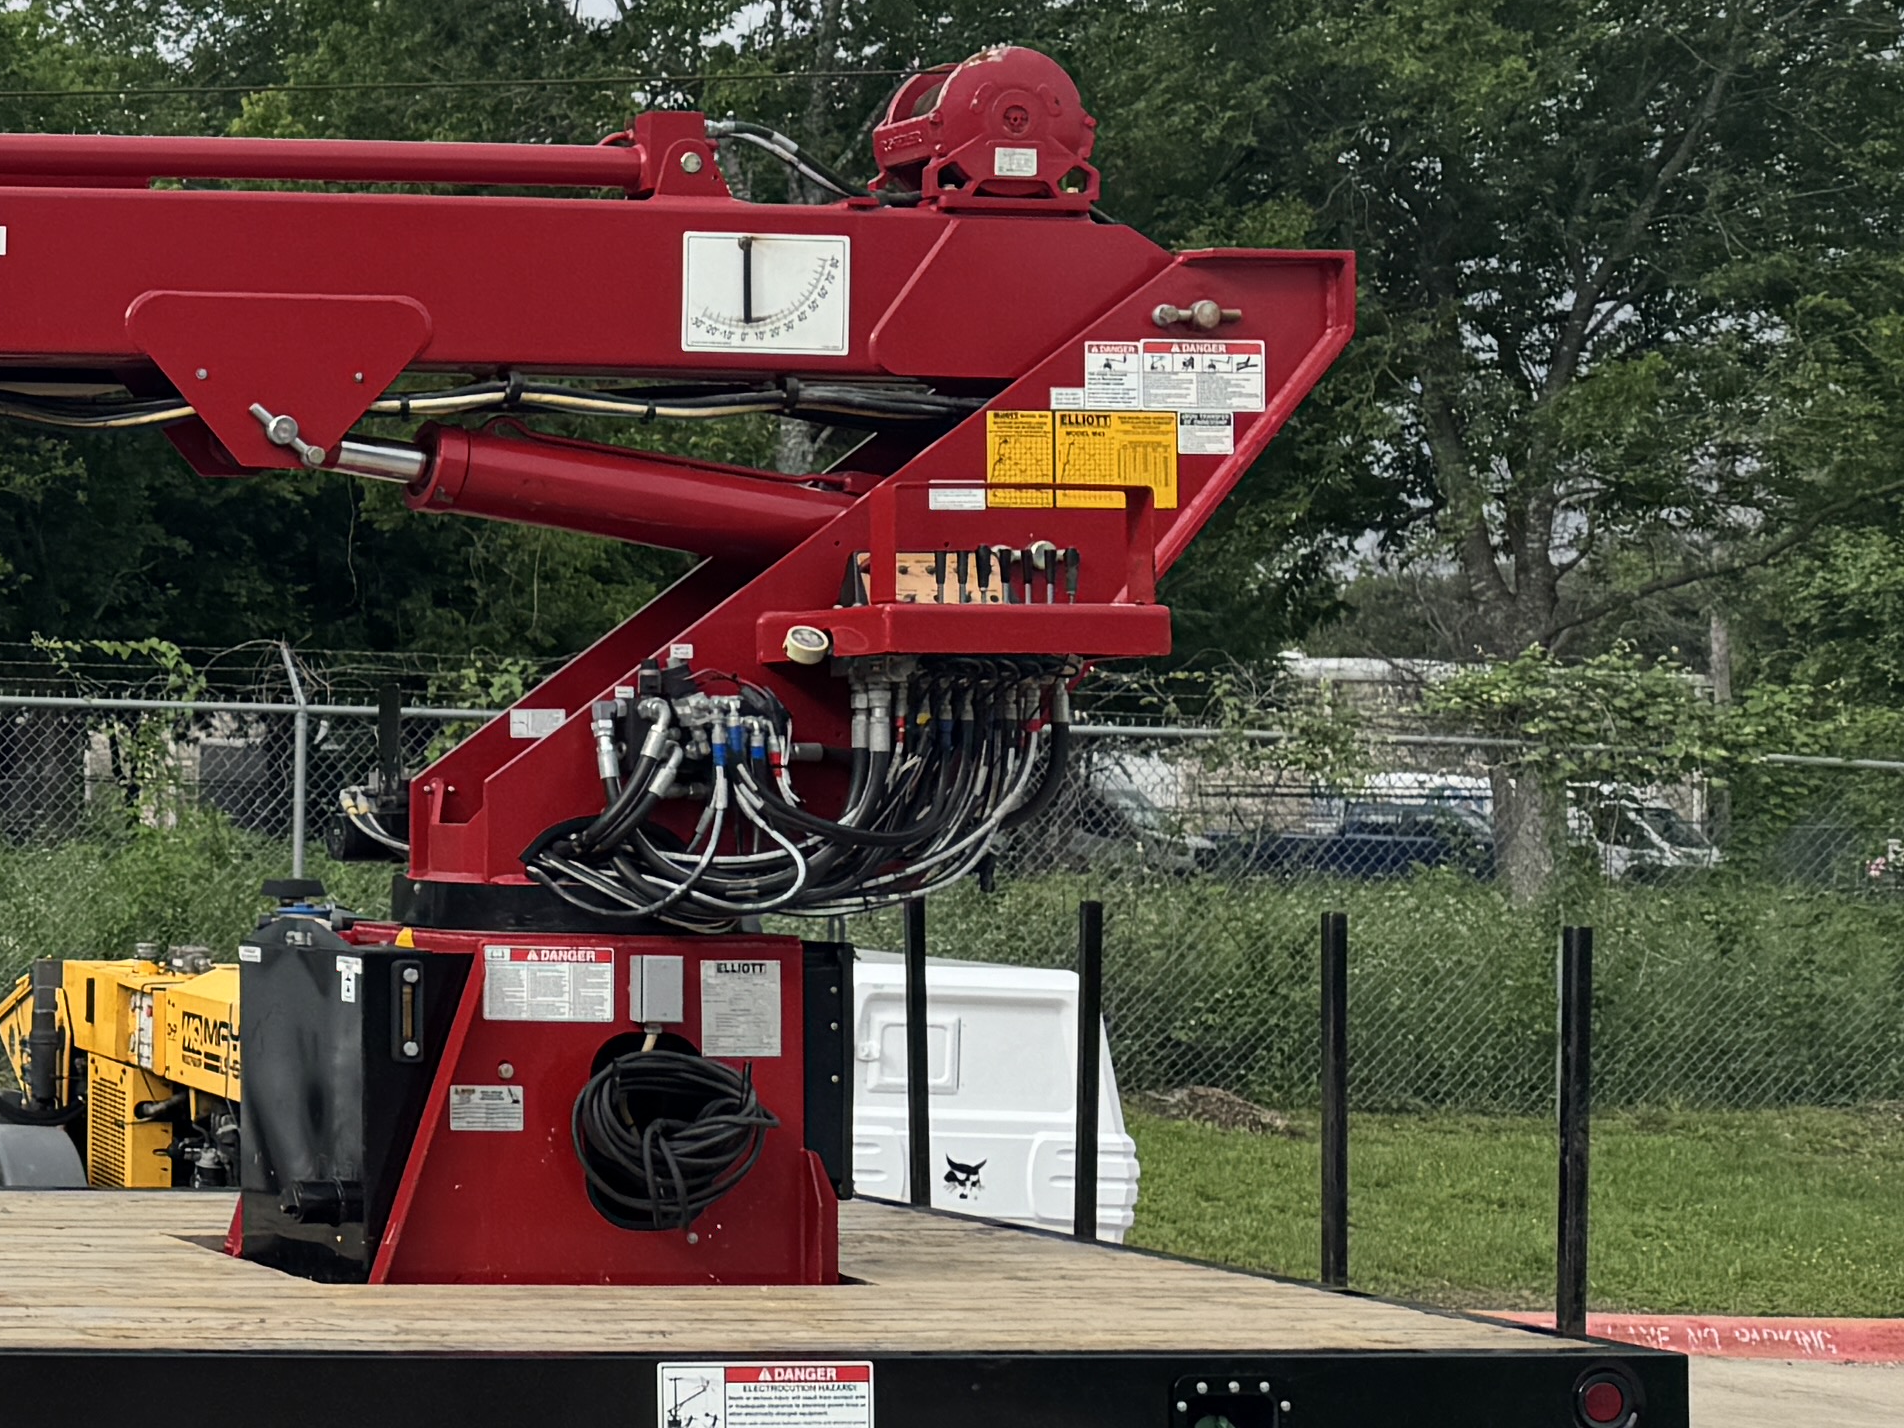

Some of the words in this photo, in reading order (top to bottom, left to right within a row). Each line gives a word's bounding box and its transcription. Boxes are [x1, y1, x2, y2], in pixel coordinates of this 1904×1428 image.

[1100, 345, 1135, 354] DANGER
[1182, 343, 1226, 353] DANGER
[1060, 414, 1110, 428] ELLIOTT
[540, 950, 596, 962] DANGER
[716, 963, 766, 974] ELLIOTT
[774, 1368, 837, 1381] DANGER
[743, 1384, 817, 1392] ELECTROCUTION
